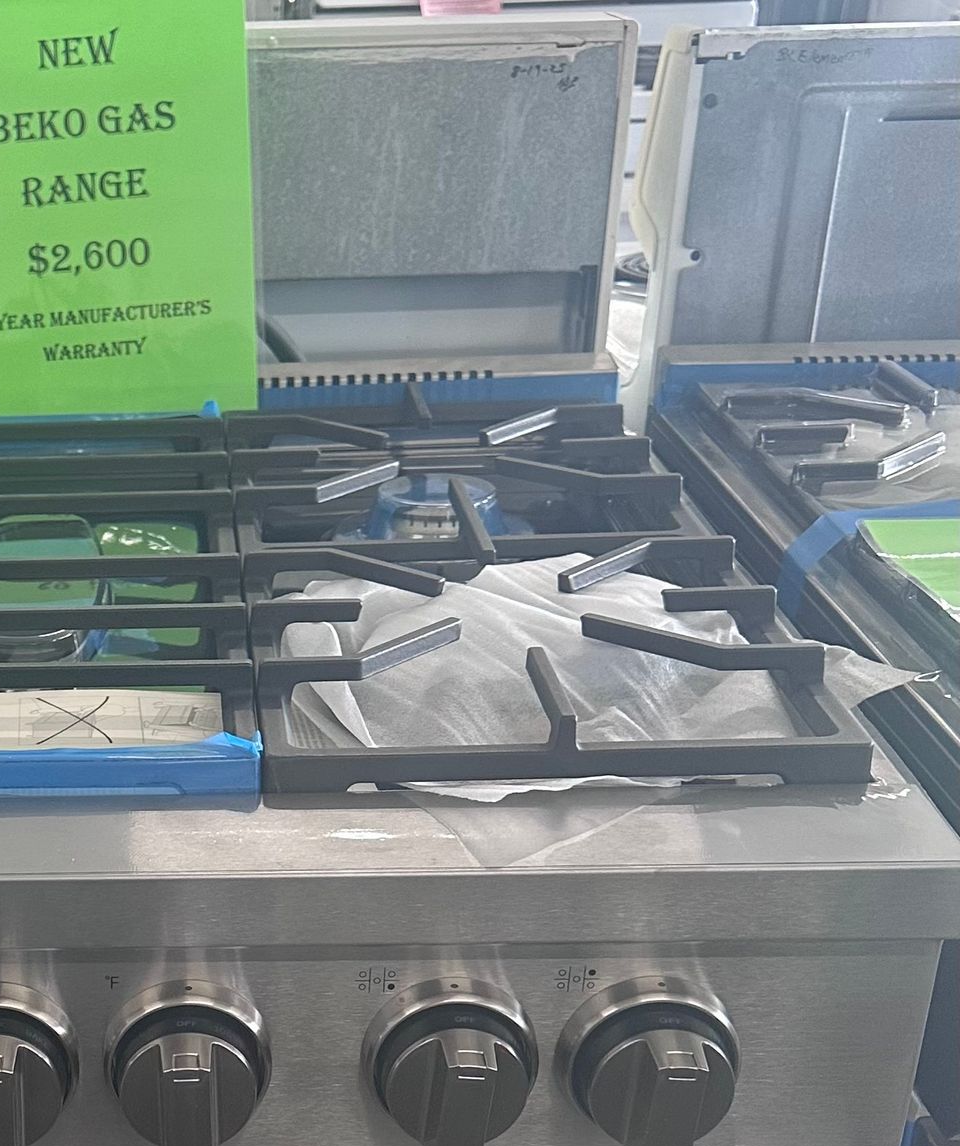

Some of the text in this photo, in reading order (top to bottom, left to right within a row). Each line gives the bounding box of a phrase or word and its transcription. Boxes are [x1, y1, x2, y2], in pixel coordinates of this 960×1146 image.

[37, 27, 119, 70] NEW
[96, 100, 177, 135] GAS
[21, 168, 151, 208] RANGE
[27, 237, 151, 278] $2,600
[49, 299, 212, 329] MANUFACTURER'S
[43, 336, 147, 362] WARRANTY
